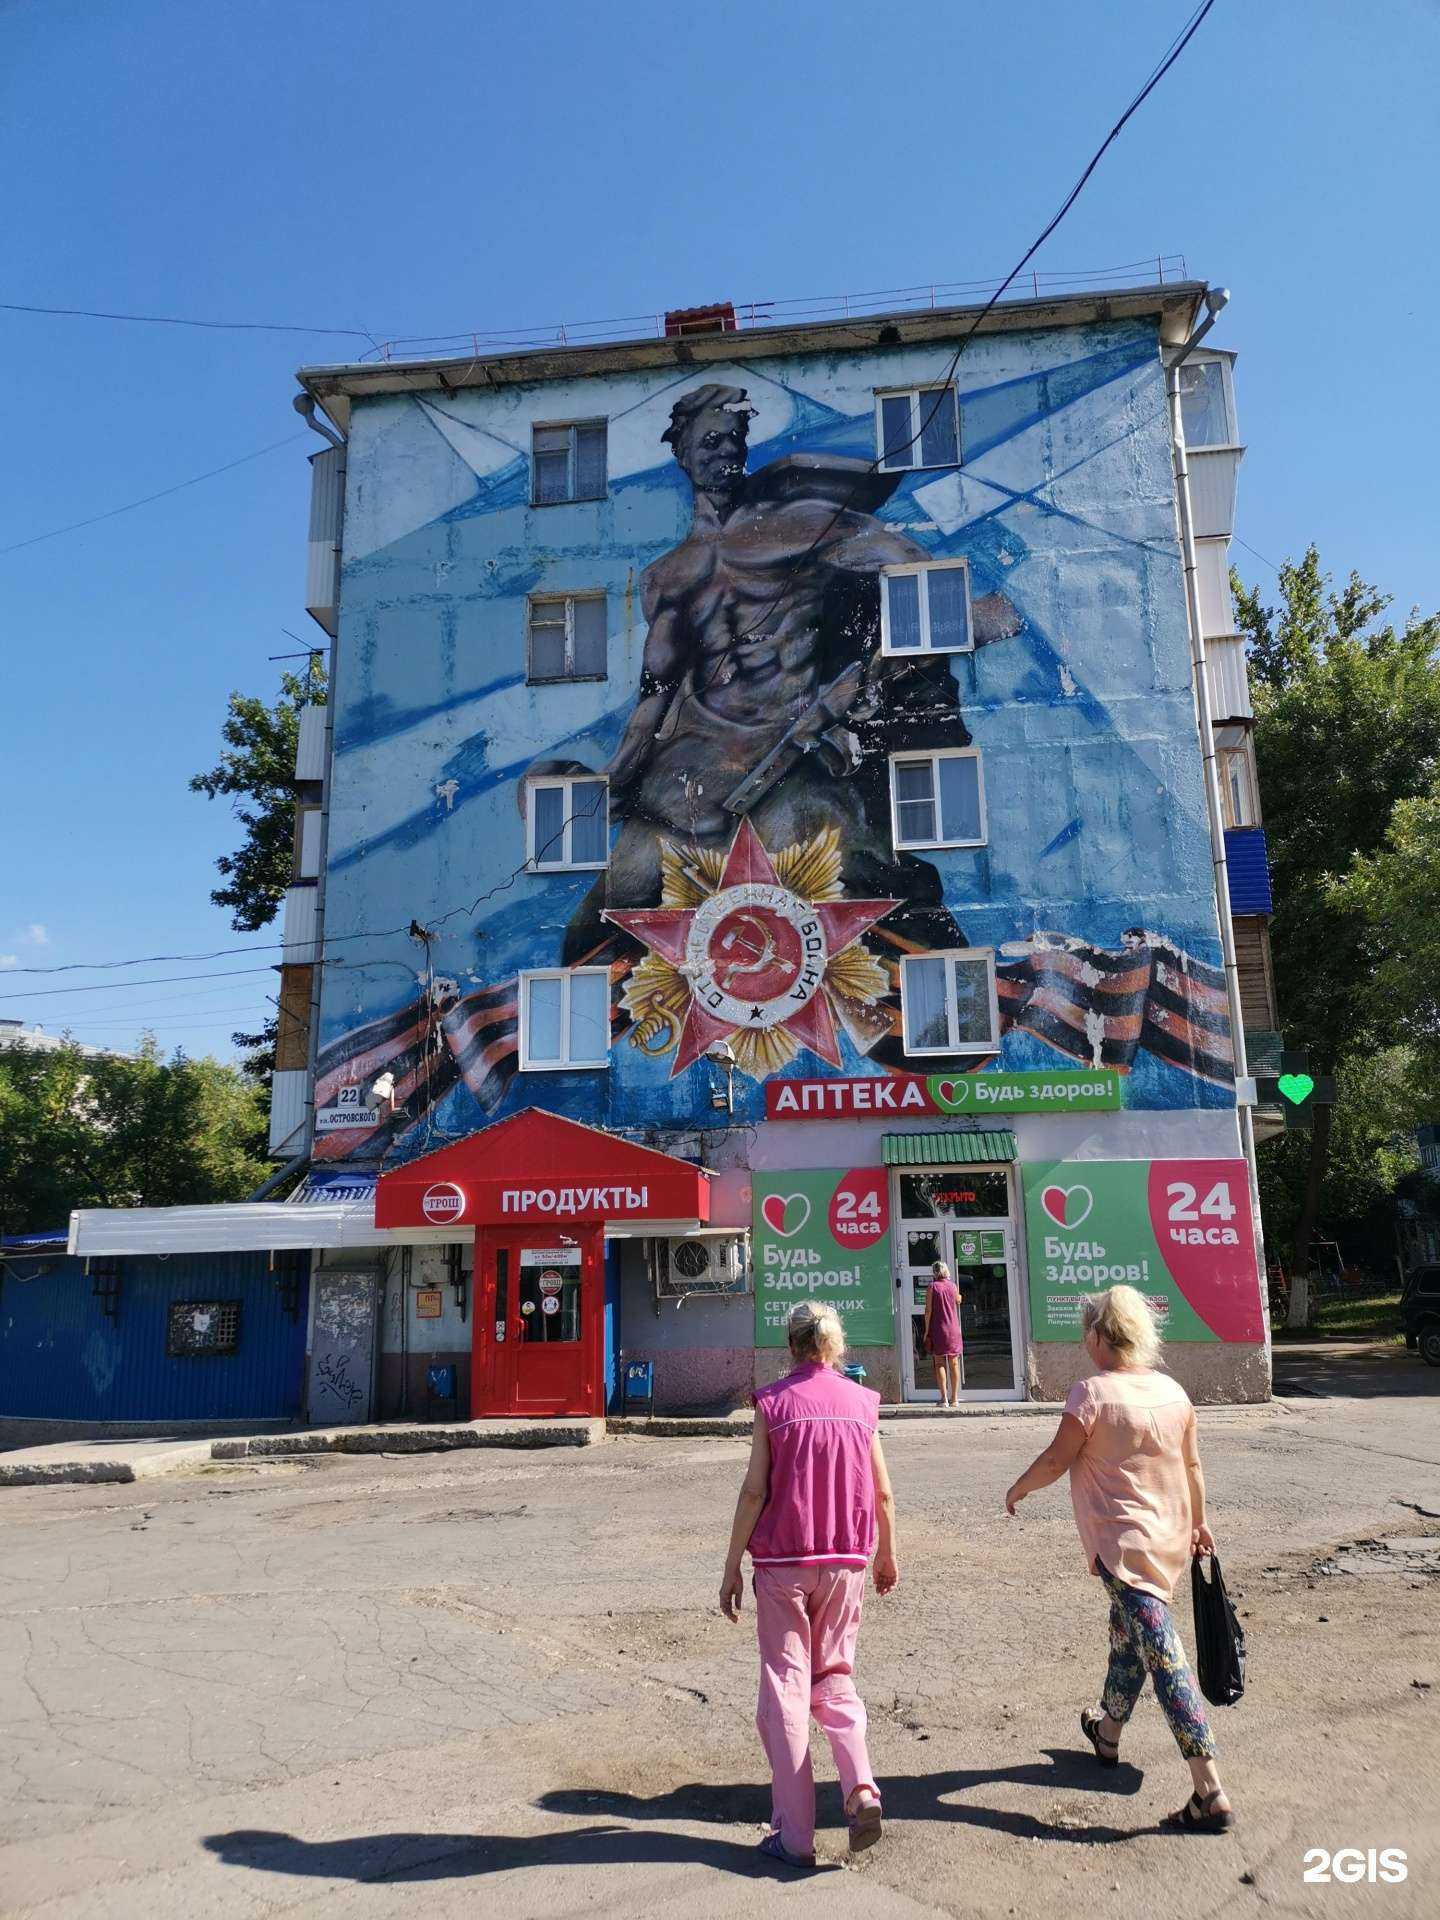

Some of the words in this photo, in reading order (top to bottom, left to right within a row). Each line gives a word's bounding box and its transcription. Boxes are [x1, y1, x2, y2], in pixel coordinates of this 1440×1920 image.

[340, 1089, 358, 1103] 22
[775, 1081, 926, 1111] АПТЕКА
[975, 1082, 1025, 1104] Будь
[1029, 1080, 1113, 1102] здоров!
[429, 1198, 460, 1209] ГРОШ
[502, 1186, 649, 1216] ПРОДУКТЫ
[836, 1191, 881, 1219] 24
[1166, 1182, 1237, 1221] 24
[836, 1221, 882, 1234] часа
[1169, 1227, 1240, 1245] часа
[763, 1244, 822, 1271] Будь
[1044, 1236, 1107, 1264] Будь
[763, 1265, 861, 1293] здоров!
[1046, 1260, 1150, 1288] здоров!
